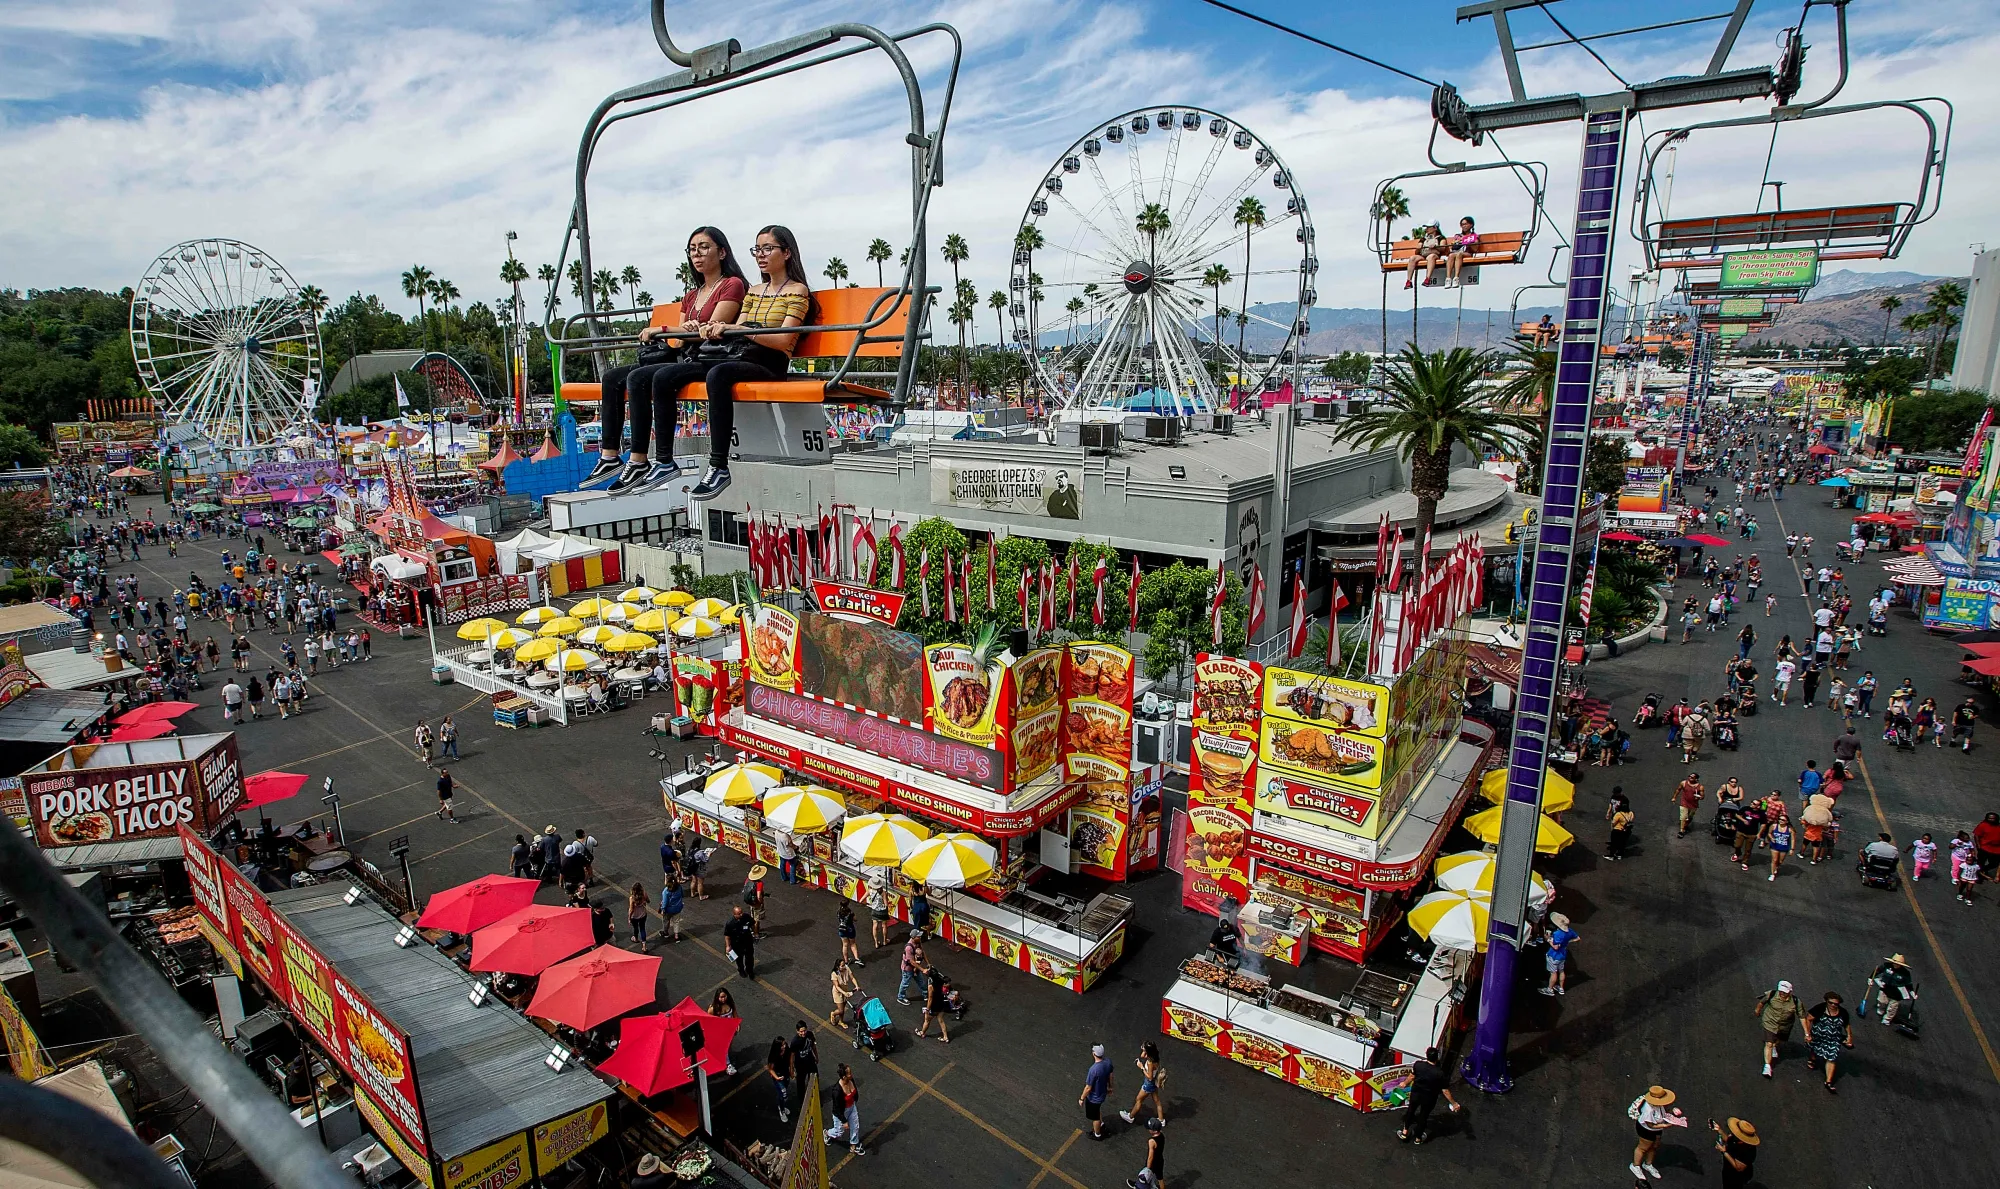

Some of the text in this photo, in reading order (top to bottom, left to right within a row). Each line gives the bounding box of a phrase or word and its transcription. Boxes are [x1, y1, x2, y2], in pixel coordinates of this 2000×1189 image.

[1770, 261, 1810, 269] anything
[1738, 272, 1758, 280] from
[802, 430, 824, 452] 55
[962, 468, 1036, 483] GEORGE LOPEZ'S
[957, 484, 1043, 498] CHINGON KITCHEN
[838, 587, 876, 602] Chicken
[824, 595, 892, 619] Charlie's
[767, 619, 793, 637] SHRIMP
[770, 611, 794, 629] NAKED
[937, 651, 955, 661] AUI
[933, 661, 974, 673] CHICKEN
[1202, 663, 1254, 682] KABOBS
[1270, 672, 1294, 680] Totally
[760, 674, 769, 682] Rice
[1277, 679, 1296, 687] Fried
[1308, 679, 1377, 700] Cheesecake
[1075, 705, 1122, 721] BACON SHRIMP
[751, 685, 990, 779] CHICKEN CHARLIE'S
[946, 725, 959, 737] Rice
[966, 731, 995, 741] Pineapple
[1018, 713, 1057, 739] FRIED SHRIMP
[1274, 728, 1293, 736] Fried
[735, 733, 790, 758] MAUI CHICKEN
[1202, 735, 1224, 749] Krispy
[1224, 739, 1246, 752] Kreme
[1327, 734, 1375, 755] CHICKEN
[1331, 744, 1371, 763] STRIPS
[1272, 752, 1287, 761] with
[1272, 757, 1299, 768] Zucchini
[203, 750, 227, 786] GIANT
[805, 757, 880, 789] BACON WRAPPED SHRIMP
[1075, 761, 1119, 778] MAUI CHICKEN
[0, 779, 15, 790] UAS
[31, 776, 75, 795] BUBBA'S
[207, 760, 238, 802] TURKEY
[1131, 780, 1162, 802] OREO
[39, 768, 187, 821] PORK BELLY
[218, 780, 240, 815] LEGS
[897, 787, 973, 820] NAKED SHRIMP
[1039, 783, 1083, 818] FRIED SHRIMP
[1309, 788, 1346, 803] Chicken
[114, 796, 194, 835] TACOS
[1293, 794, 1361, 819] Charlie's
[1193, 809, 1247, 829] BACON WRAPPED
[1205, 816, 1233, 829] PICKLE
[1250, 835, 1352, 872] FROG LEGS
[1266, 850, 1333, 873] TOTALLY FRIED!
[1194, 865, 1238, 876] TOTALLY FRIED!
[1362, 873, 1409, 882] Charlie's
[1278, 871, 1341, 894] FRIED VEGGIES
[1257, 891, 1296, 908] CHICKEN
[1341, 916, 1358, 928] RIBS
[286, 936, 317, 981] GIANT
[1033, 949, 1070, 968] MAUI CHICKEN
[281, 950, 336, 1028] TURKEY
[334, 978, 404, 1056] CRAZY FRIES
[1172, 1008, 1218, 1031] COOKIE DOUGH
[1232, 1031, 1284, 1054] BACON WRAPPED
[1303, 1056, 1352, 1081] FROG LEGS
[1373, 1070, 1399, 1083] COTTON
[347, 1038, 419, 1124] HOT CHEETO FRIES
[350, 1054, 425, 1145] CHILI CHEESE FRIES
[550, 1111, 587, 1141] GIANT
[544, 1120, 592, 1157] TURKEY
[555, 1136, 586, 1162] LEGS
[453, 1144, 522, 1189] MOUTH-WATERING
